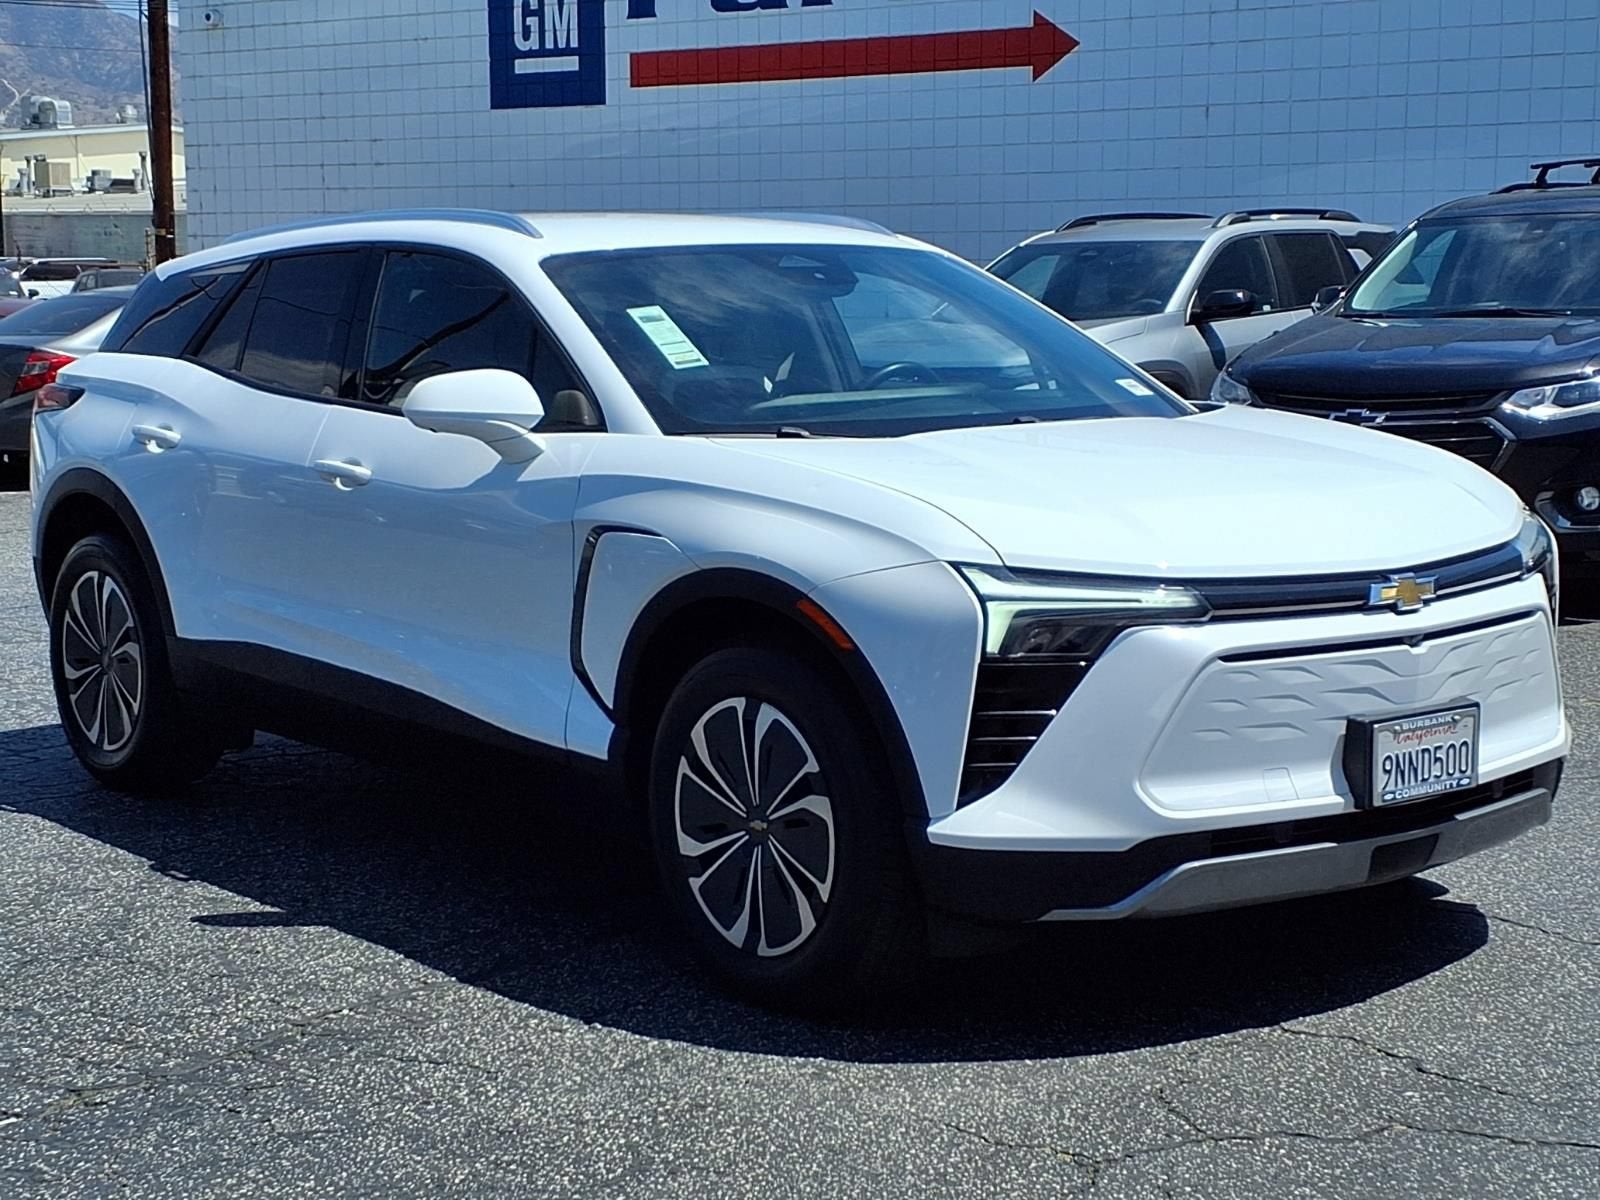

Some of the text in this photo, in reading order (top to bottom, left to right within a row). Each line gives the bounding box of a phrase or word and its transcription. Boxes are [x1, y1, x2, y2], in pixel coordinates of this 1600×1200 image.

[513, 0, 579, 51] GM
[1402, 714, 1453, 730] BURBANK
[1382, 740, 1469, 791] 9NND500
[1395, 779, 1458, 799] COMMUNITY
